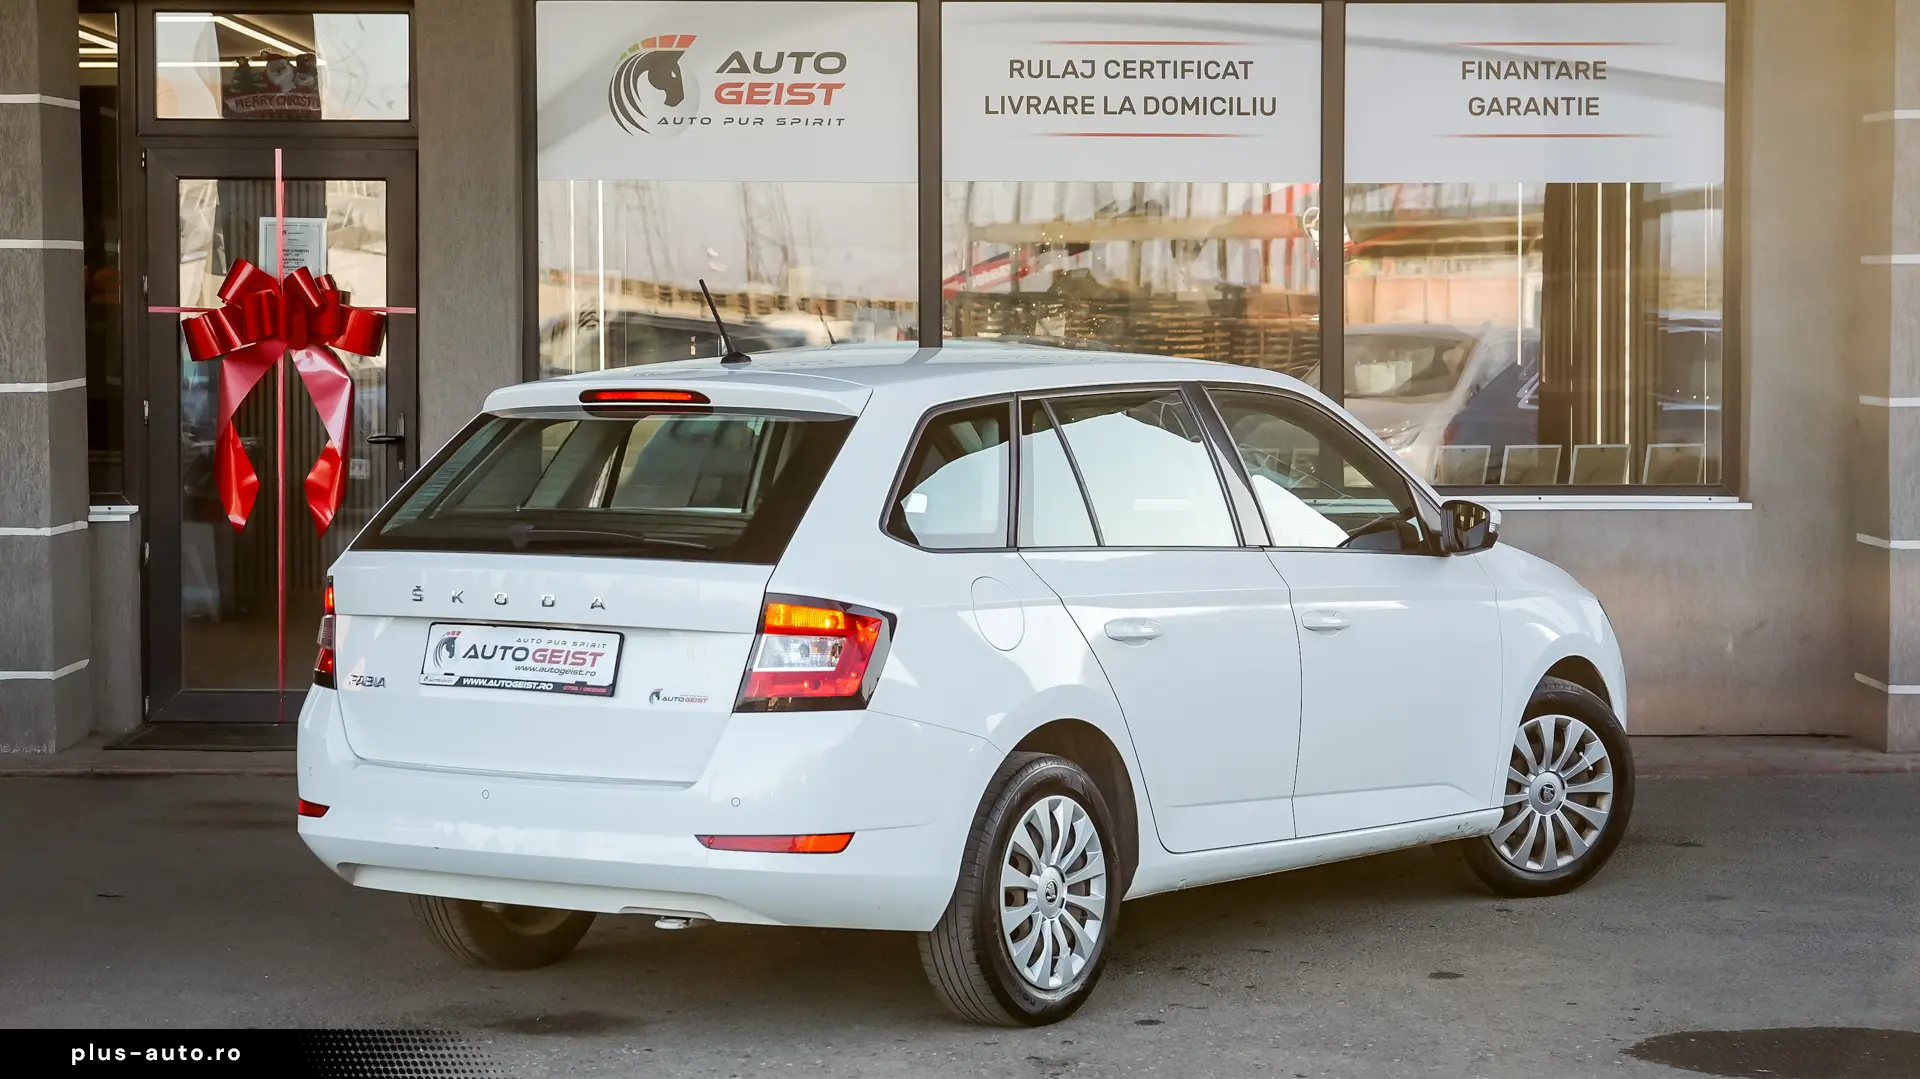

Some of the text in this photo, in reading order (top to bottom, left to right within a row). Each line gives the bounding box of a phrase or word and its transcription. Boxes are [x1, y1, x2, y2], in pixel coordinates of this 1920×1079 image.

[715, 50, 847, 75] AUTO
[1009, 59, 1254, 80] RULAJ CERTIFICAT
[1461, 60, 1607, 80] FINANTARE
[234, 95, 273, 110] MERRY
[714, 82, 846, 106] GEIST
[984, 95, 1277, 116] LIVRARE LA DOMICILIU
[1468, 96, 1600, 116] GARANTIE
[657, 116, 846, 127] AUTO PUR SPIRIT
[412, 585, 606, 610] ŠKODA
[572, 641, 607, 649] SPIRIT
[514, 665, 597, 677] www.autogeist.ro
[349, 674, 387, 689] FABIA
[462, 677, 554, 691] WWW.AUTOGEIST.RO
